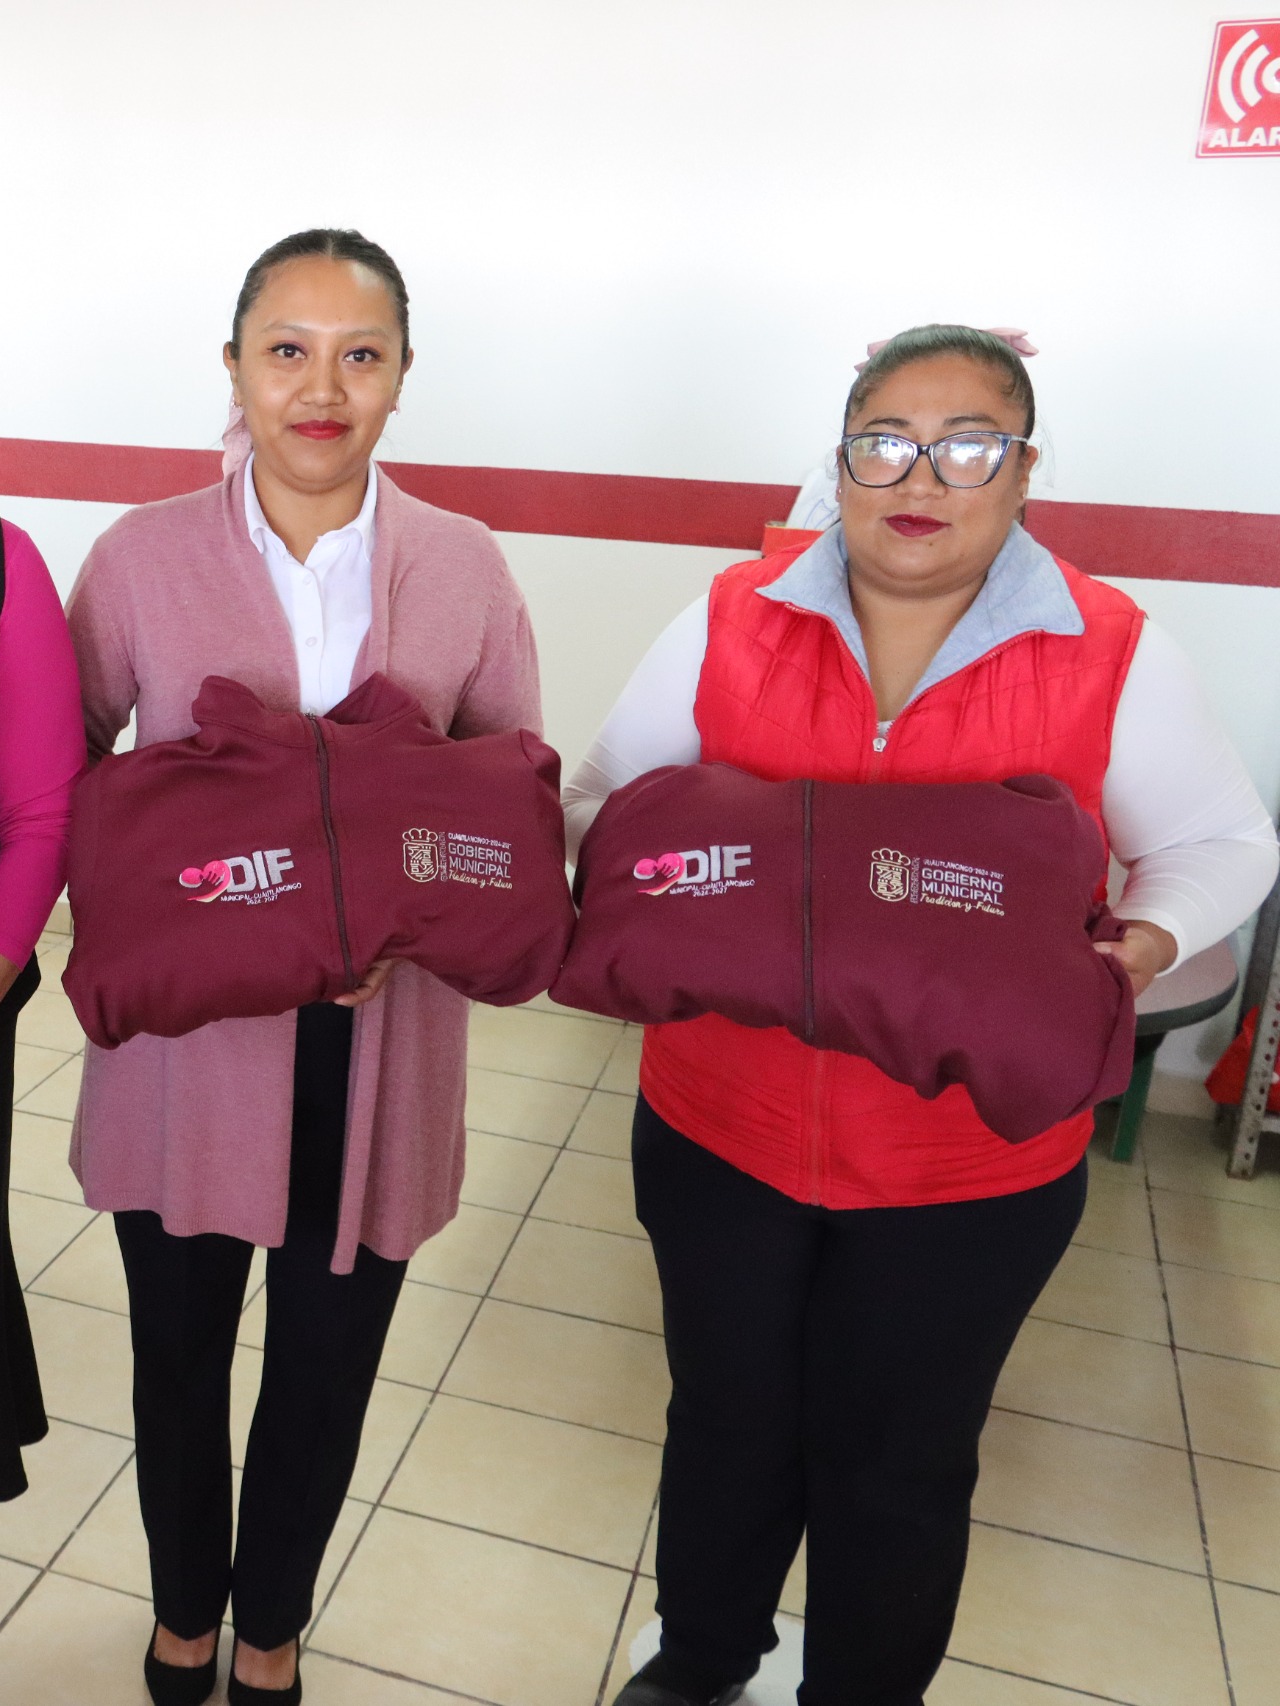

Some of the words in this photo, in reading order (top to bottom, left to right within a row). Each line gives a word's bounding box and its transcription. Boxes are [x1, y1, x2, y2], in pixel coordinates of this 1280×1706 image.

[448, 842, 512, 864] GOBIERNO
[677, 845, 751, 885] DIF
[222, 848, 294, 893] DIF
[449, 856, 511, 878] MUNICIPAL
[921, 868, 1003, 893] GOBIERNO
[921, 880, 1003, 906] MUNICIPAL
[963, 902, 972, 913] y
[975, 901, 1005, 917] Futuro
